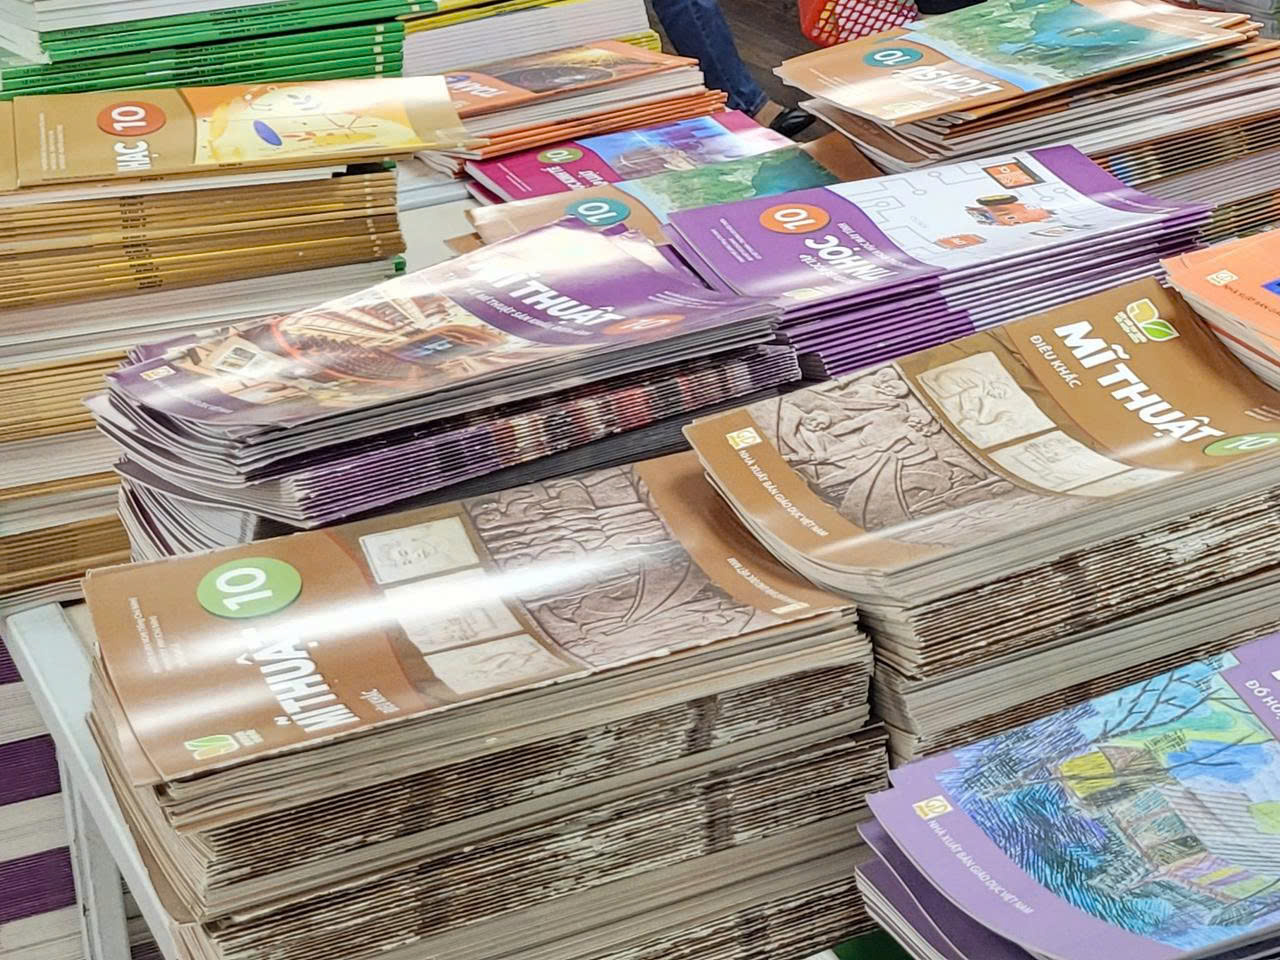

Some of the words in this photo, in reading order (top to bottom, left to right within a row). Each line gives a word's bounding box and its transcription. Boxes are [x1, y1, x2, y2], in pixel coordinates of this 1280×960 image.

[874, 49, 912, 66] 10
[112, 106, 147, 131] 10
[545, 150, 575, 162] 10
[577, 201, 617, 221] 10
[774, 208, 816, 230] 10
[804, 235, 870, 270] HỌC
[508, 280, 626, 326] THUẬT
[1029, 335, 1055, 363] ĐIÊU
[1050, 357, 1083, 389] KHẮC
[1053, 320, 1131, 369] MĨ
[1097, 362, 1228, 443] THUẬT
[1224, 433, 1279, 450] 10
[738, 449, 756, 466] NHÀ
[749, 464, 768, 481] XUẤT
[762, 480, 780, 495] BẢN
[774, 493, 792, 508] GIÁO
[216, 567, 273, 611] 10
[236, 628, 337, 715] THUẬT
[1245, 677, 1267, 697] ĐỒ
[274, 703, 360, 733] MĨ
[928, 820, 947, 836] NHÀ
[941, 835, 962, 853] XUẤT
[956, 851, 976, 868] BẢN
[969, 865, 991, 881] GIÁO
